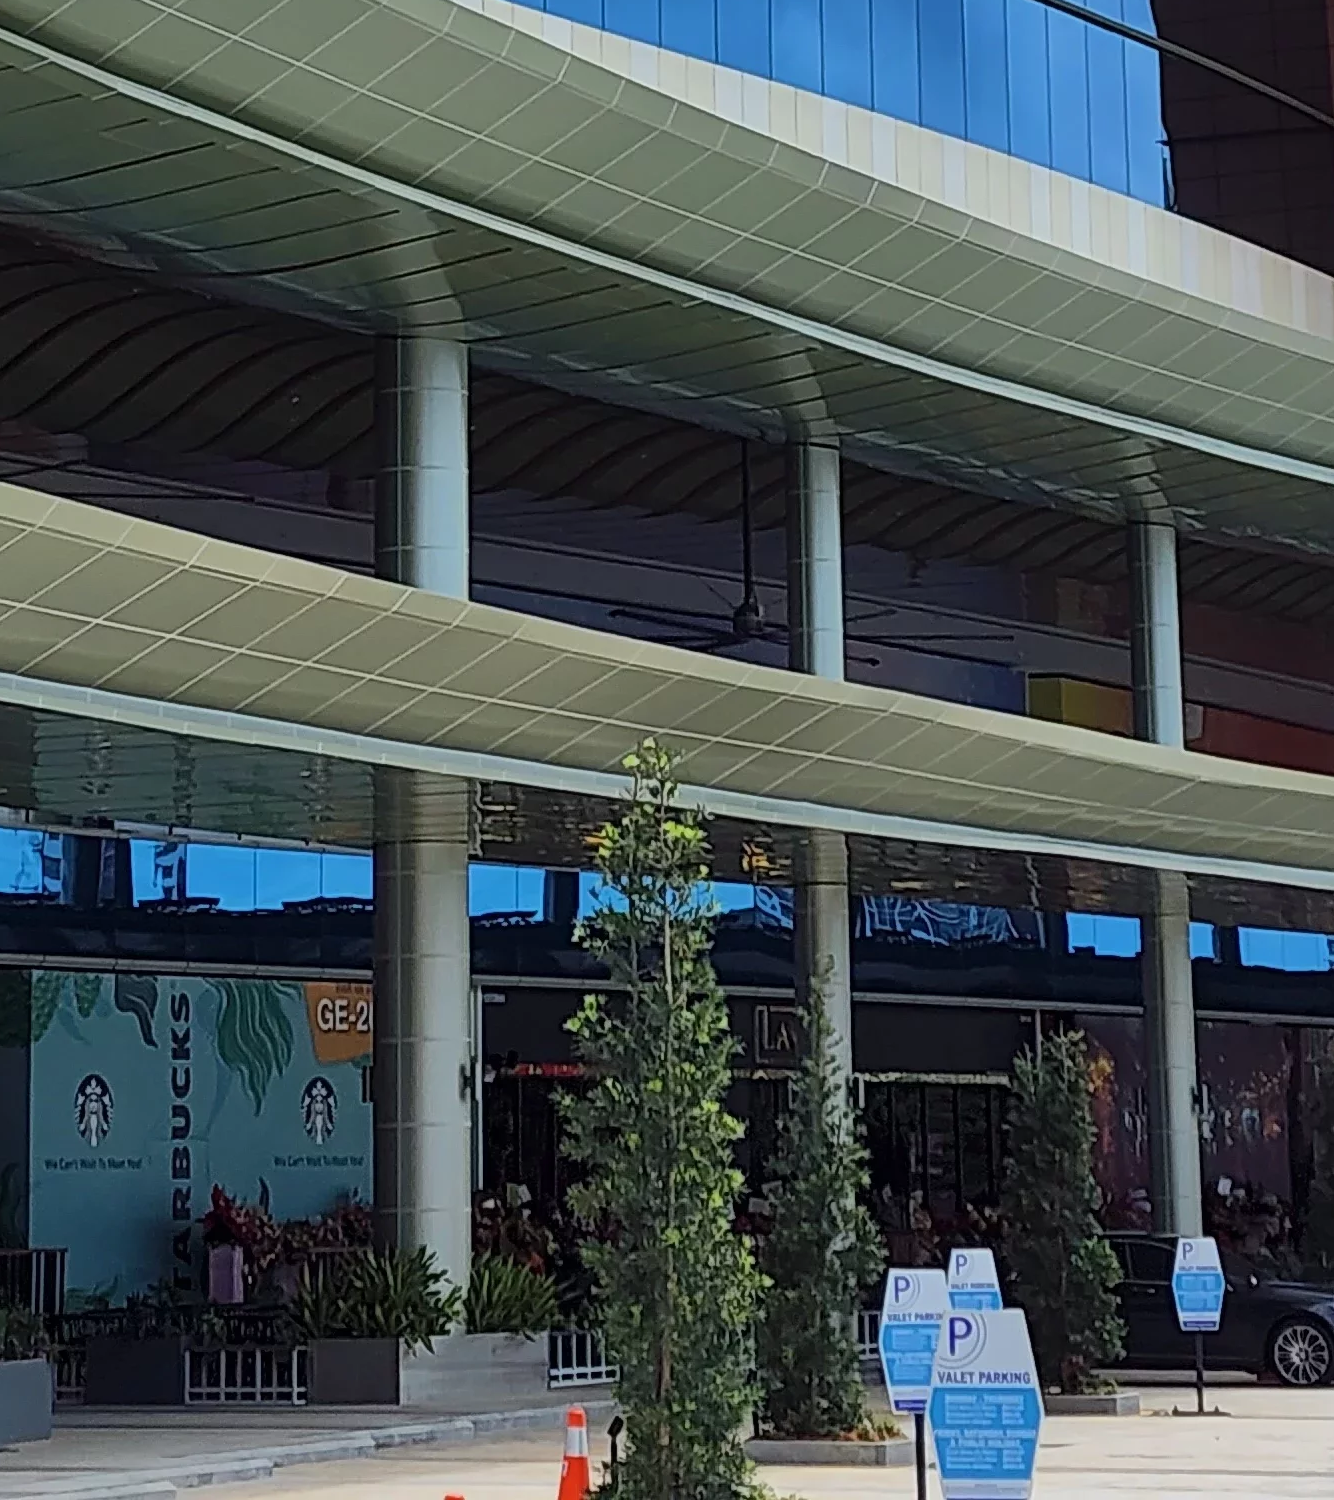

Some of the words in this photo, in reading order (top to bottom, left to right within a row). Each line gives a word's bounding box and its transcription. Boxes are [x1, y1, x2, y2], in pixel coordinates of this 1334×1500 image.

[170, 991, 192, 1292] TARBUCKS
[955, 1254, 968, 1276] P
[894, 1275, 910, 1303] P
[887, 1313, 914, 1322] VALET
[914, 1313, 944, 1322] PARKIN
[949, 1316, 972, 1356] P
[938, 1371, 975, 1384] VALET
[979, 1371, 1031, 1384] PARKING
